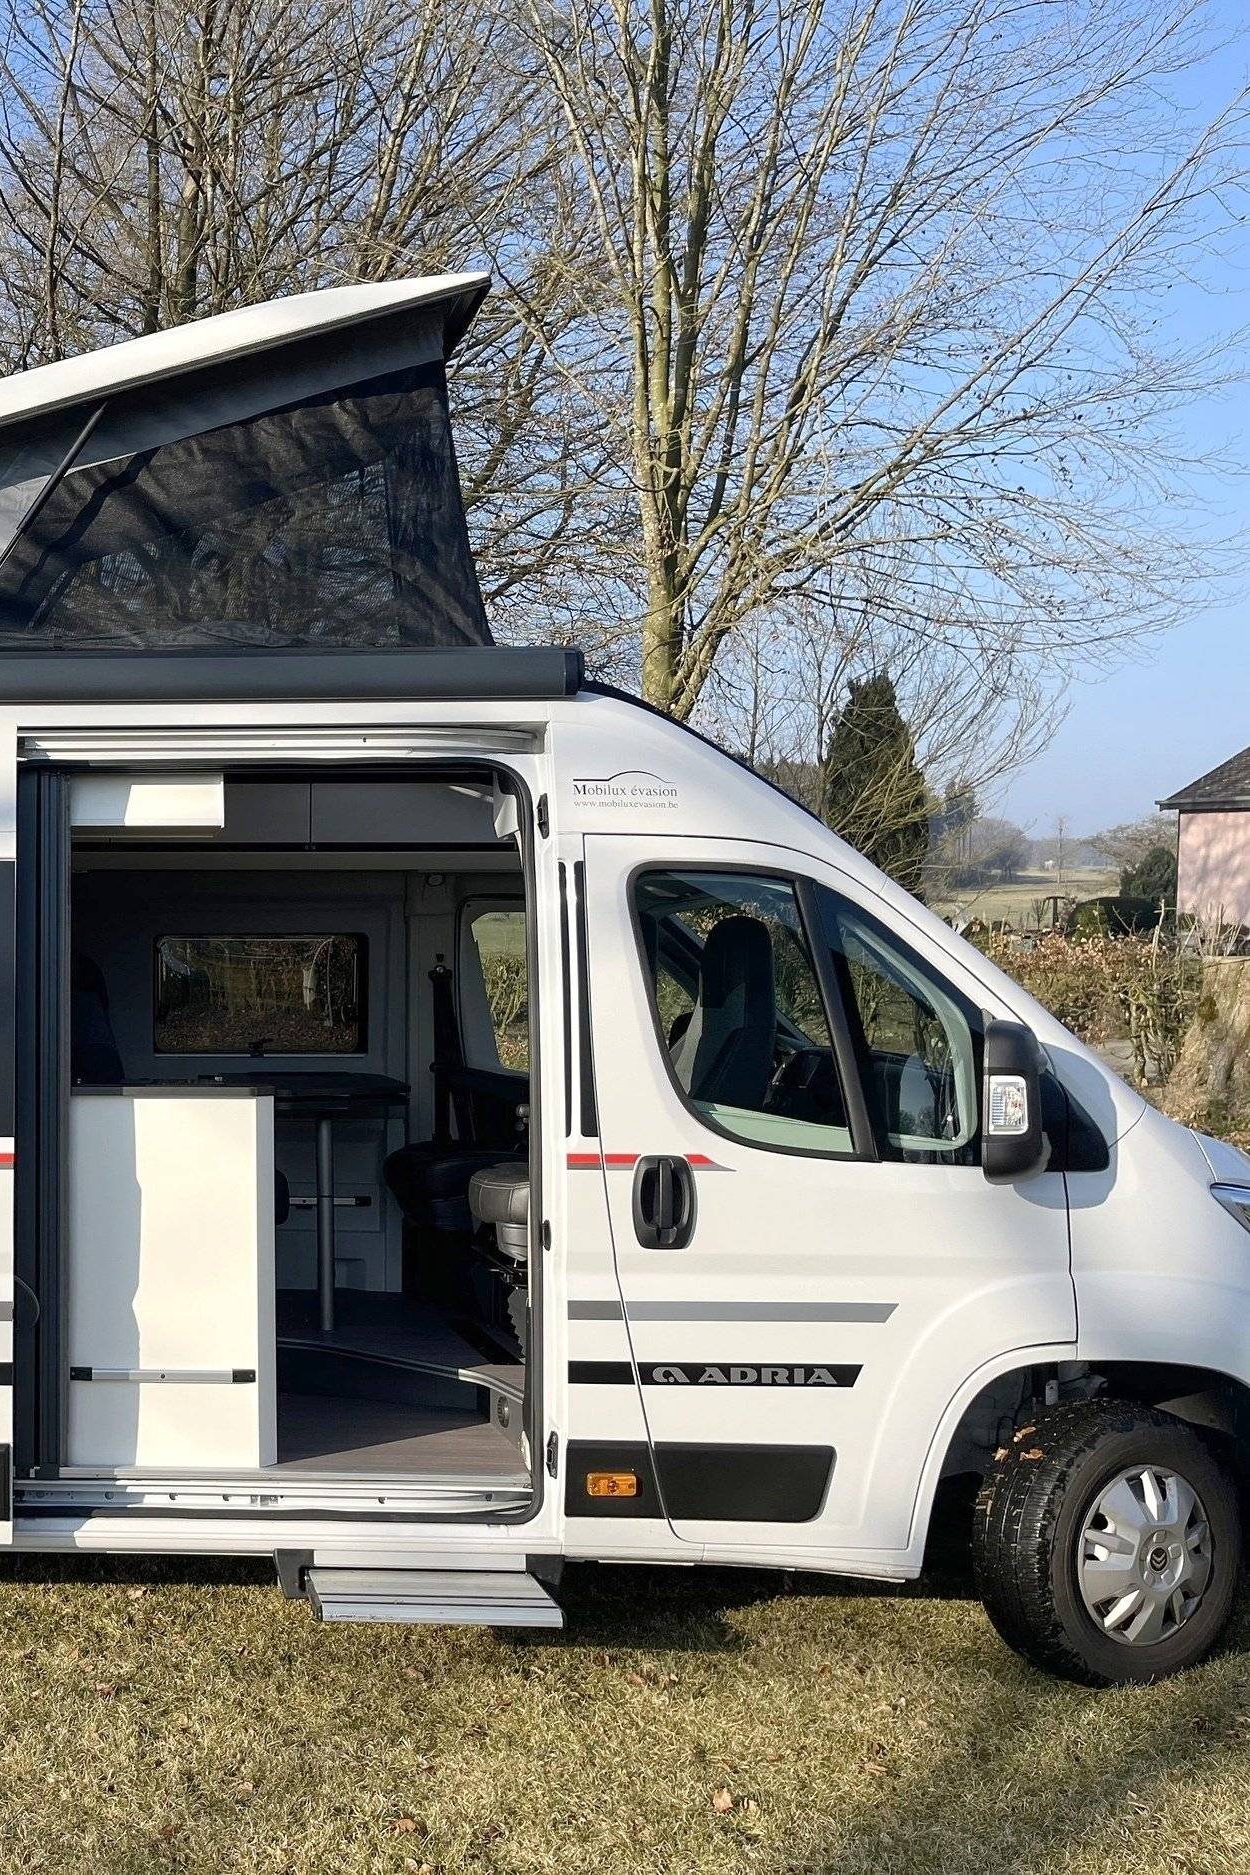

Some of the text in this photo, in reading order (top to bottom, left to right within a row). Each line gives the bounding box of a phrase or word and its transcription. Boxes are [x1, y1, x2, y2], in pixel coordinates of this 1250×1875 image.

[573, 784, 678, 797] Mobilux évasion
[573, 800, 679, 809] www.mobiluxevasion.be
[698, 1366, 838, 1385] ADRIA
